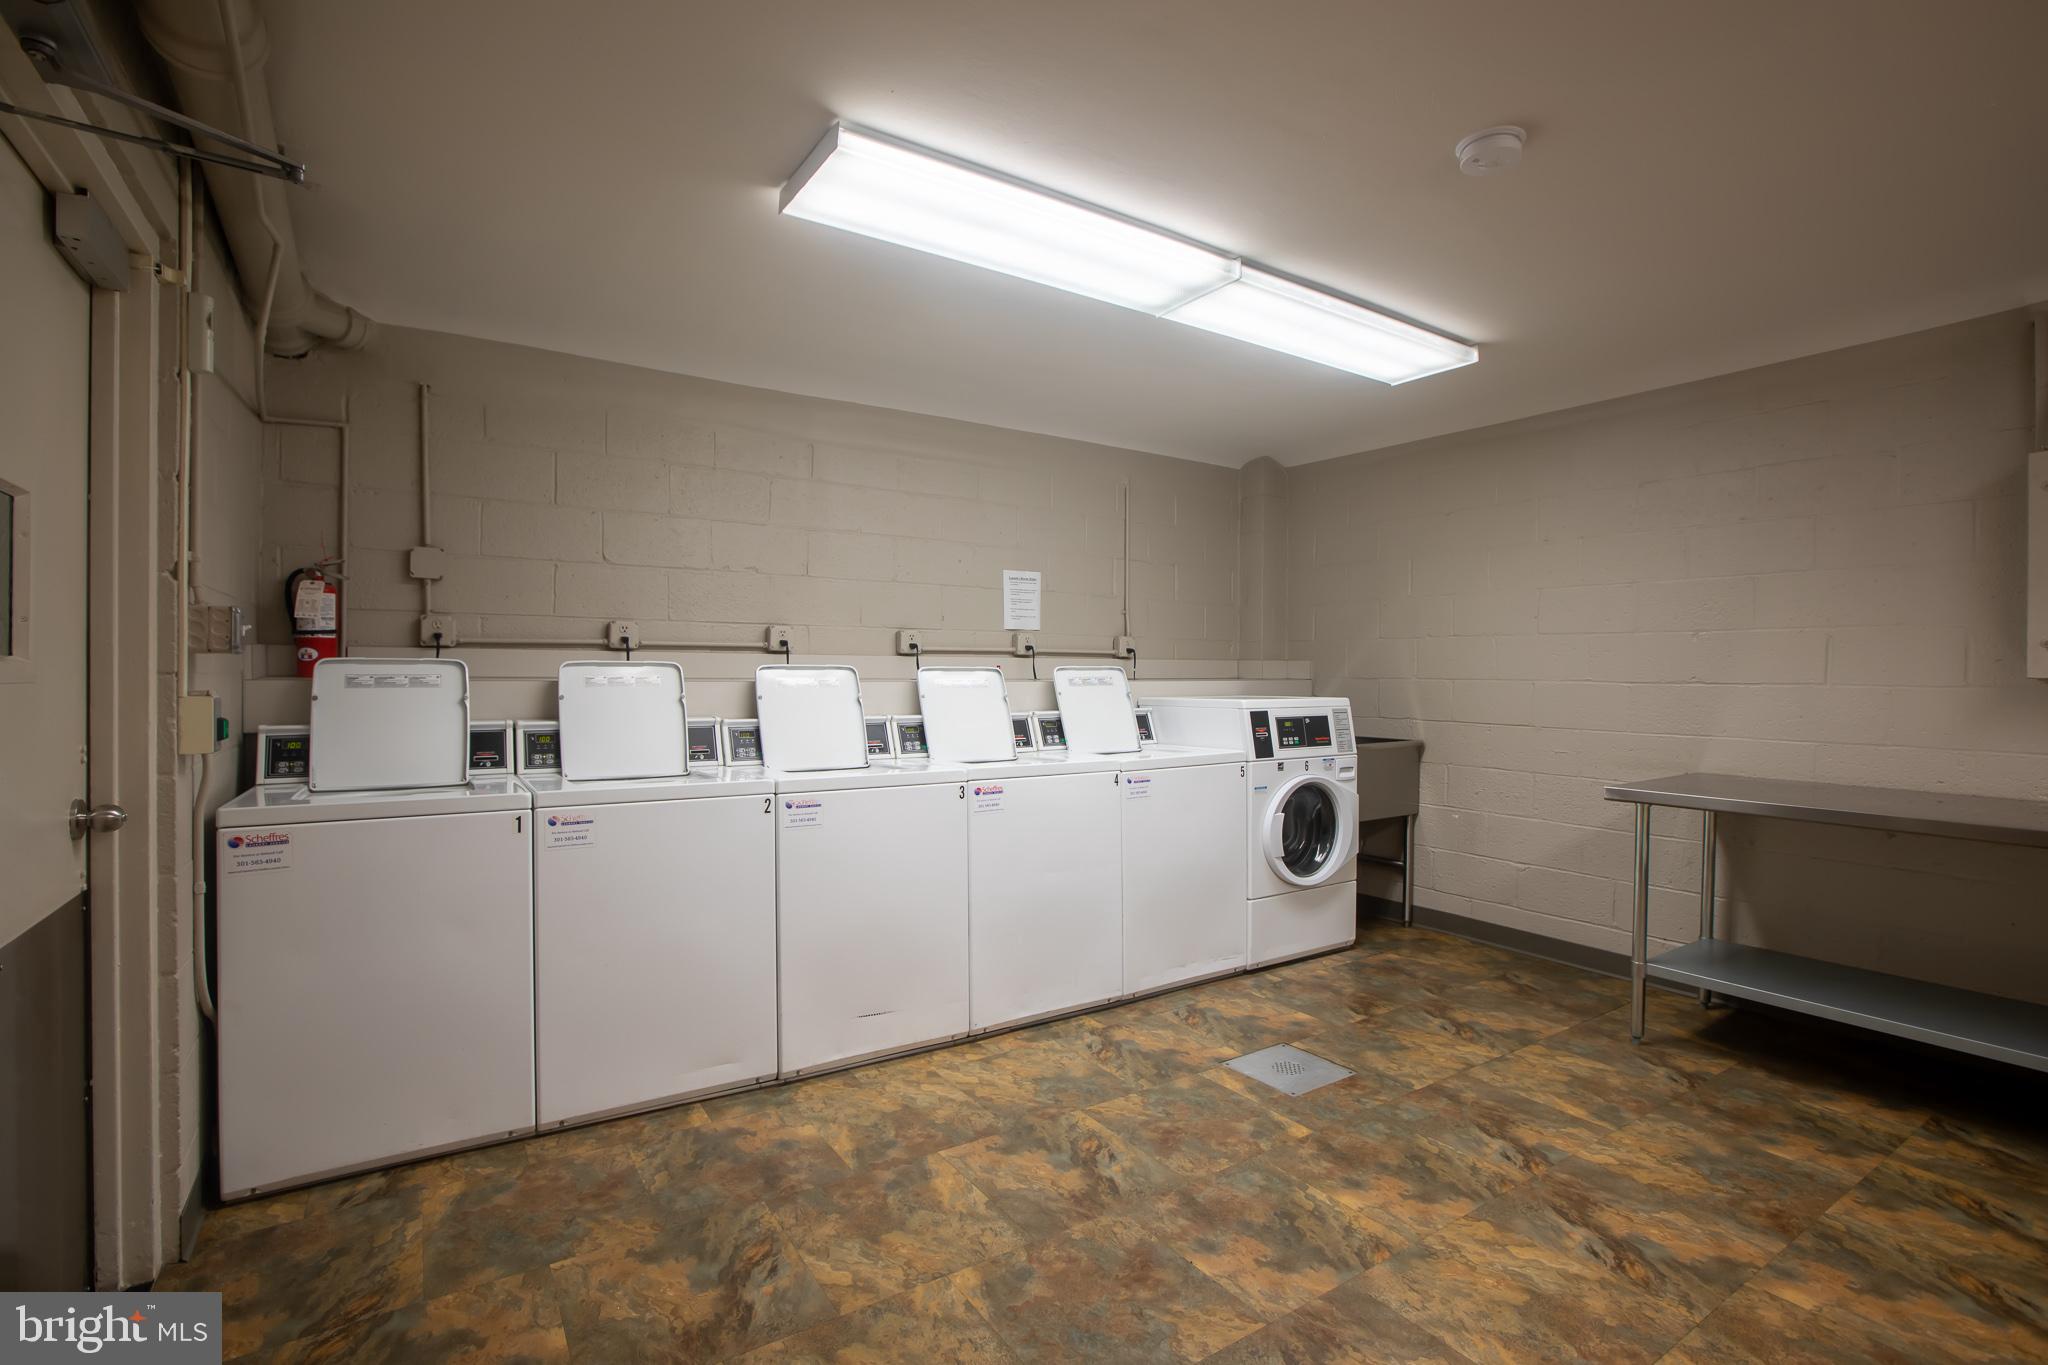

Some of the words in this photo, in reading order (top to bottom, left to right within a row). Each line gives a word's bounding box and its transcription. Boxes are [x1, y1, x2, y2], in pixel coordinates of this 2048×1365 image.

[1240, 766, 1245, 777] 5
[1304, 760, 1309, 771] 6
[1114, 774, 1119, 786] 4
[959, 785, 965, 799] 3
[764, 798, 771, 813] 2
[515, 816, 522, 833] 1
[246, 832, 290, 843] Scheffres
